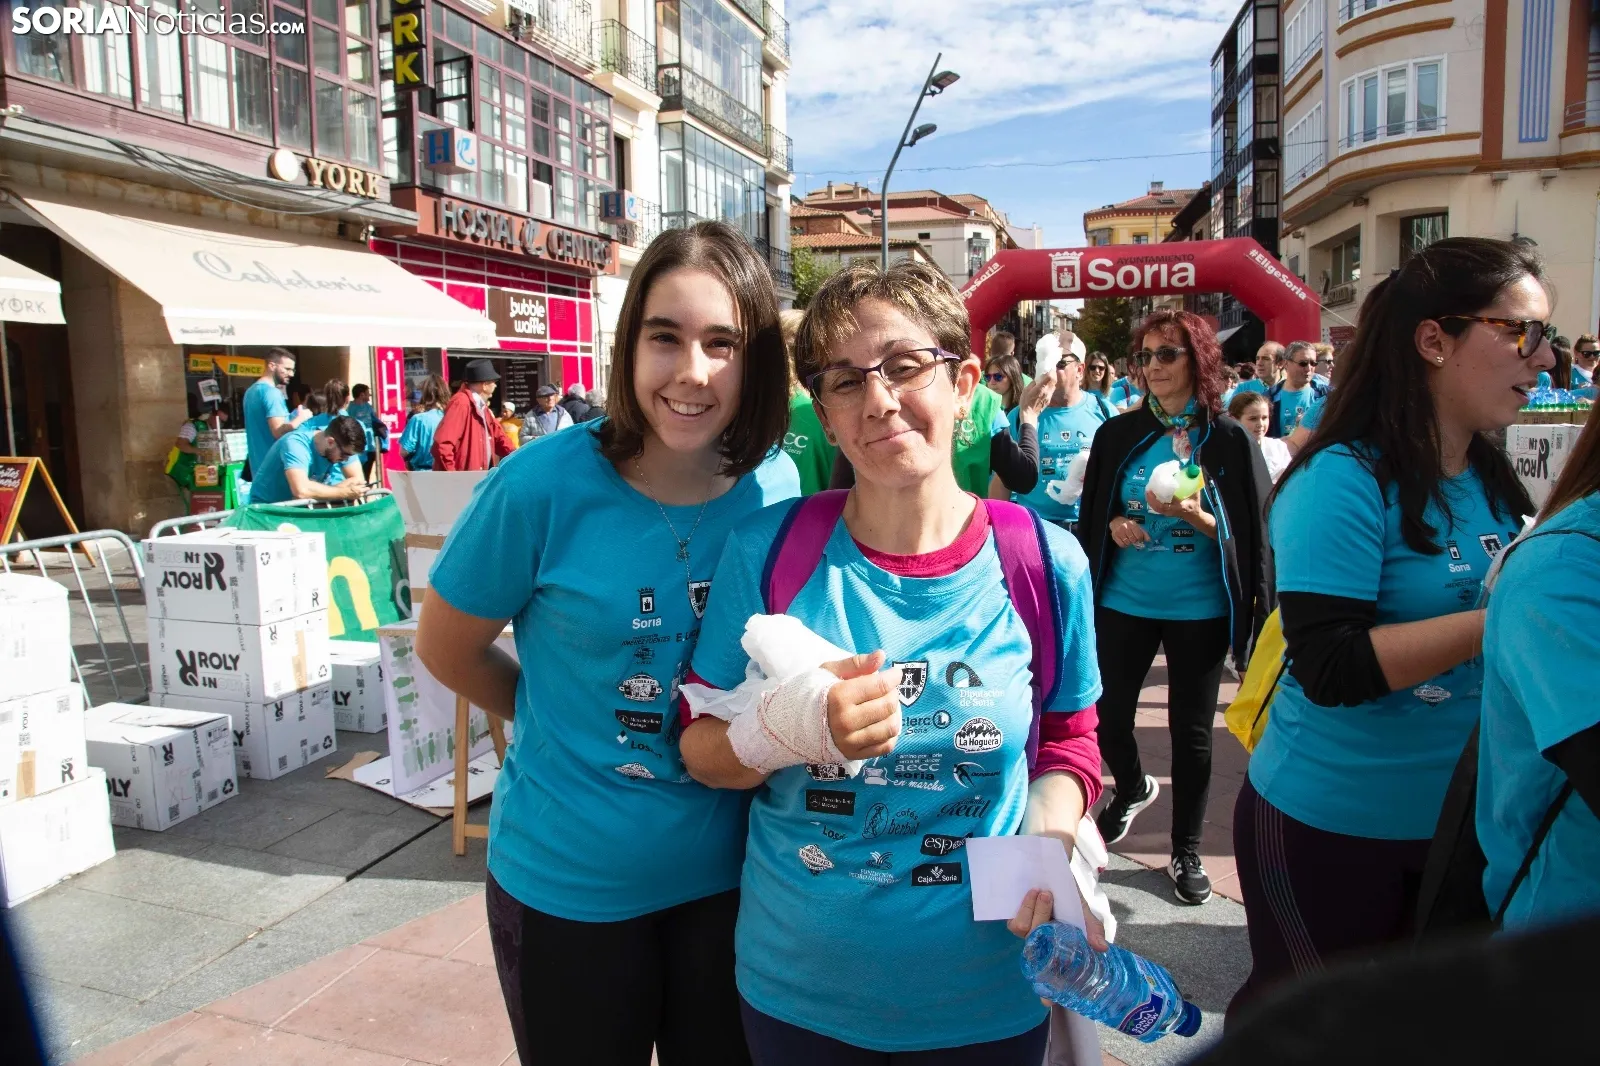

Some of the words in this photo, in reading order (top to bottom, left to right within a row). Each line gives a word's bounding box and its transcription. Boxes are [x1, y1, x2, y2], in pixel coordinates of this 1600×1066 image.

[393, 0, 420, 85] RK
[307, 158, 380, 199] YORK
[440, 197, 520, 247] HOSTAL
[550, 227, 613, 265] CENTRO
[1117, 253, 1195, 265] AYUNTAMIENTO
[961, 262, 1000, 300] geSoria
[1086, 258, 1196, 291] Soria
[1249, 249, 1306, 300] #EligeSoria
[509, 296, 546, 318] bubble
[514, 317, 546, 335] waffle
[239, 365, 262, 374] ONCE
[783, 432, 809, 448] CC
[161, 571, 203, 590] ROLY
[632, 617, 662, 630] Soria
[198, 651, 240, 671] ROLY
[333, 690, 351, 706] LY
[969, 738, 999, 748] Hoguera
[893, 771, 935, 781] soria
[894, 763, 940, 772] aecc
[908, 780, 945, 792] marcha
[917, 875, 933, 883] Caja
[941, 874, 958, 882] Soria
